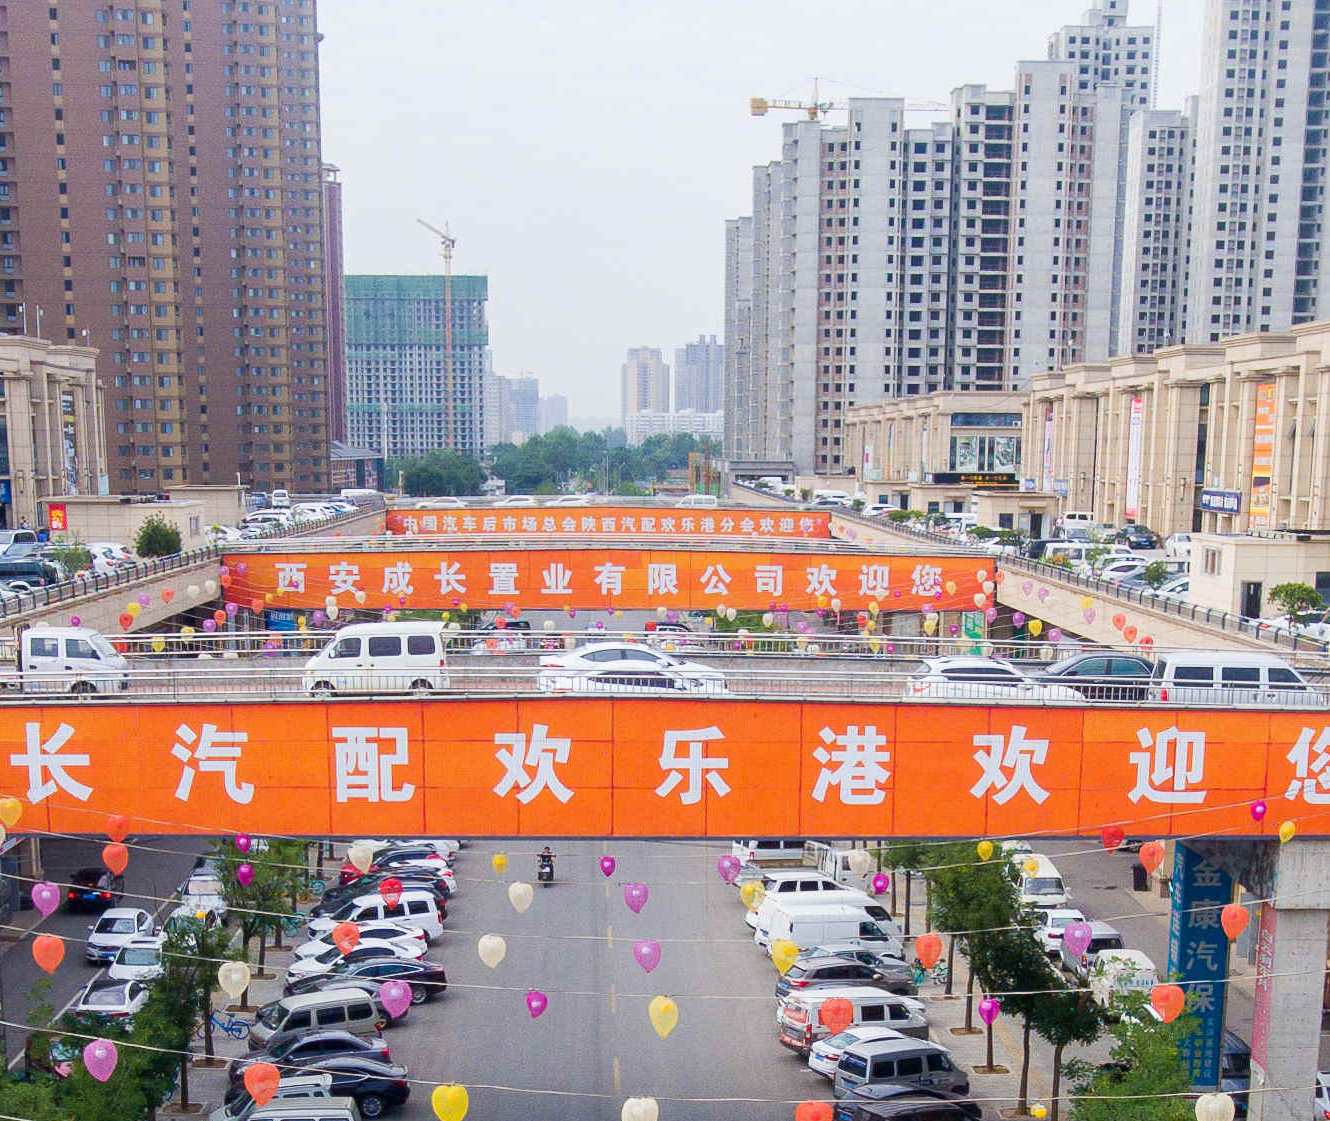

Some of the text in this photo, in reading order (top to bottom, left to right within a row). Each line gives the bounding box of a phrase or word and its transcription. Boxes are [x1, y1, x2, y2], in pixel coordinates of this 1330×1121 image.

[275, 560, 943, 598] 西安成长置业有限公司欢迎您
